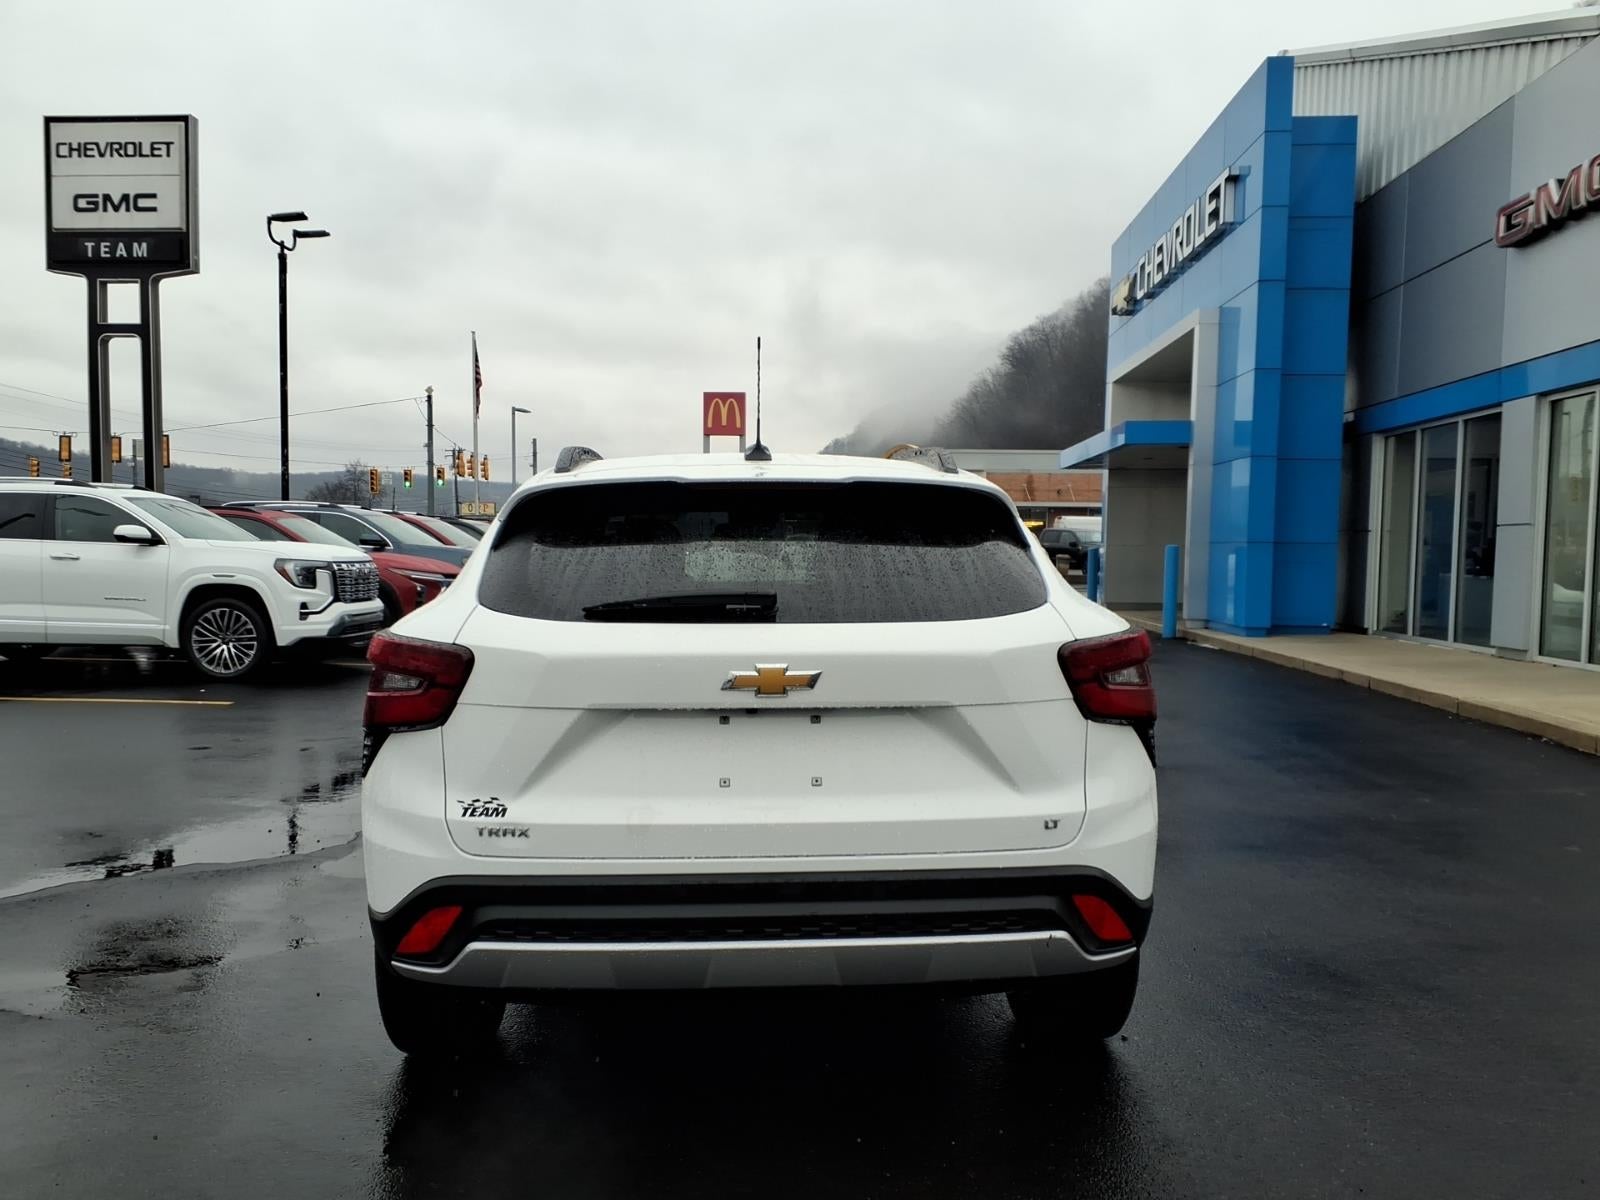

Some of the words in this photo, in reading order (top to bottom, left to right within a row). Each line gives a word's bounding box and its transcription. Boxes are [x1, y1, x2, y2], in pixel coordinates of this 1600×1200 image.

[55, 141, 175, 159] CHEVROLET
[72, 193, 158, 213] GMC
[1496, 153, 1600, 247] GM
[1136, 167, 1233, 300] CHEVROLET
[84, 242, 148, 258] TEAM
[461, 806, 508, 818] TEAM
[477, 827, 530, 839] TRAX
[1044, 819, 1061, 830] LT
